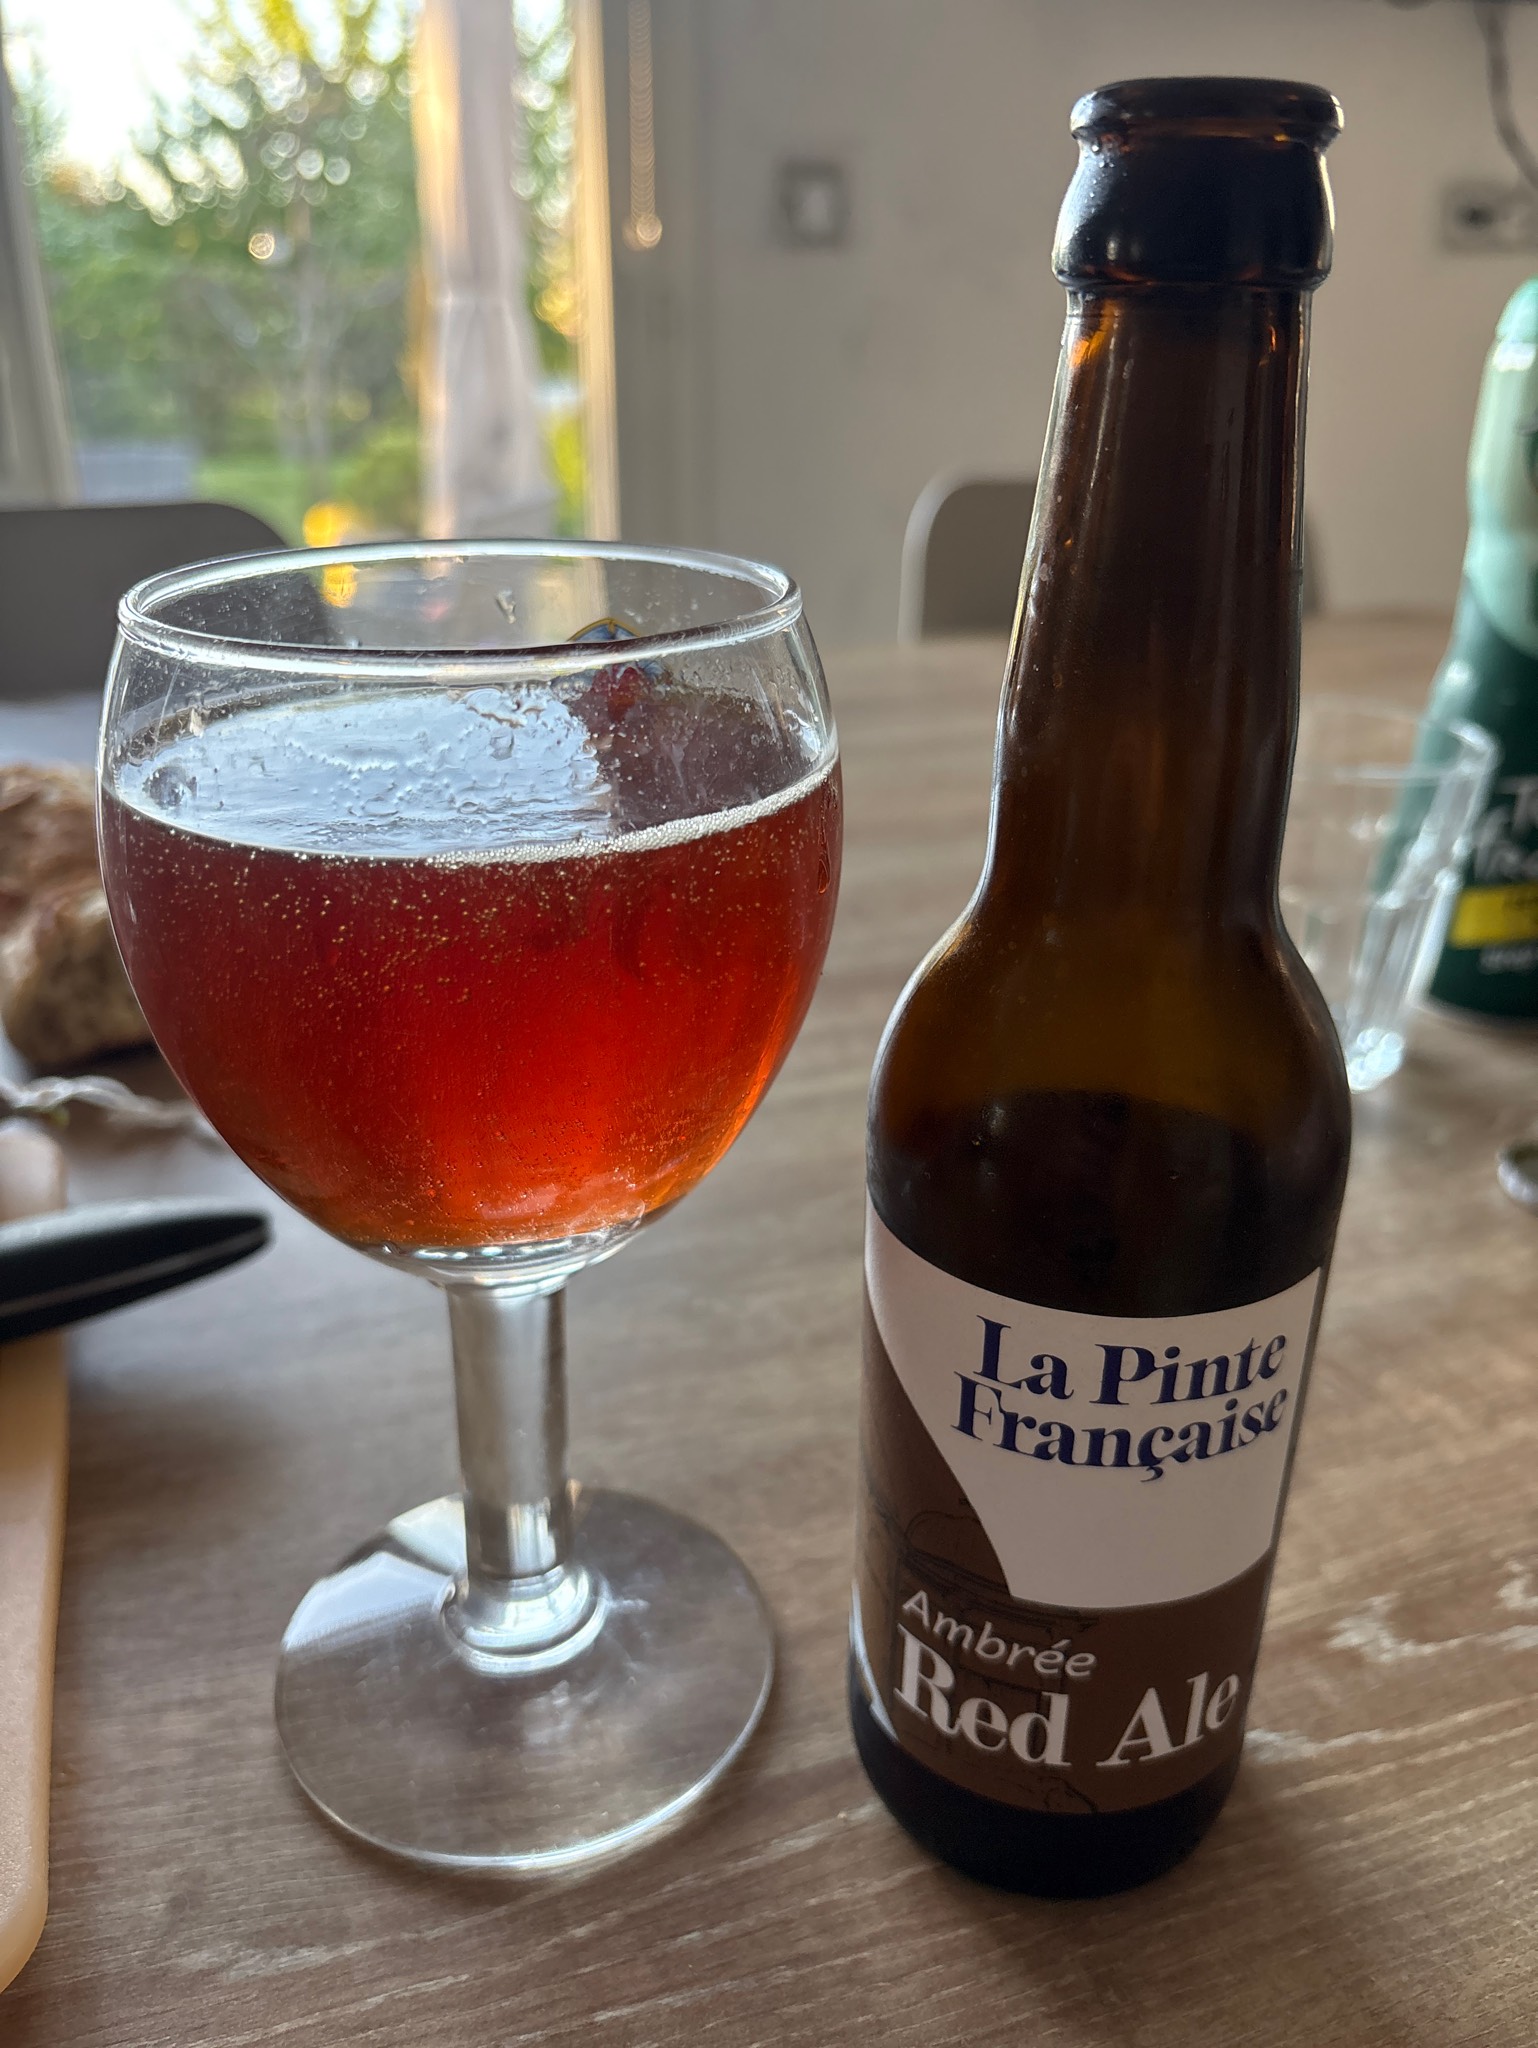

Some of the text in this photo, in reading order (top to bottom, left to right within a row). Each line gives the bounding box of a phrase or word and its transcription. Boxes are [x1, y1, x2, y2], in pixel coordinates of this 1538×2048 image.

[975, 1315, 1286, 1405] La Pinte
[952, 1373, 1287, 1482] Française
[902, 1591, 1097, 1678] Ambrée
[895, 1624, 1240, 1768] Red Ale
